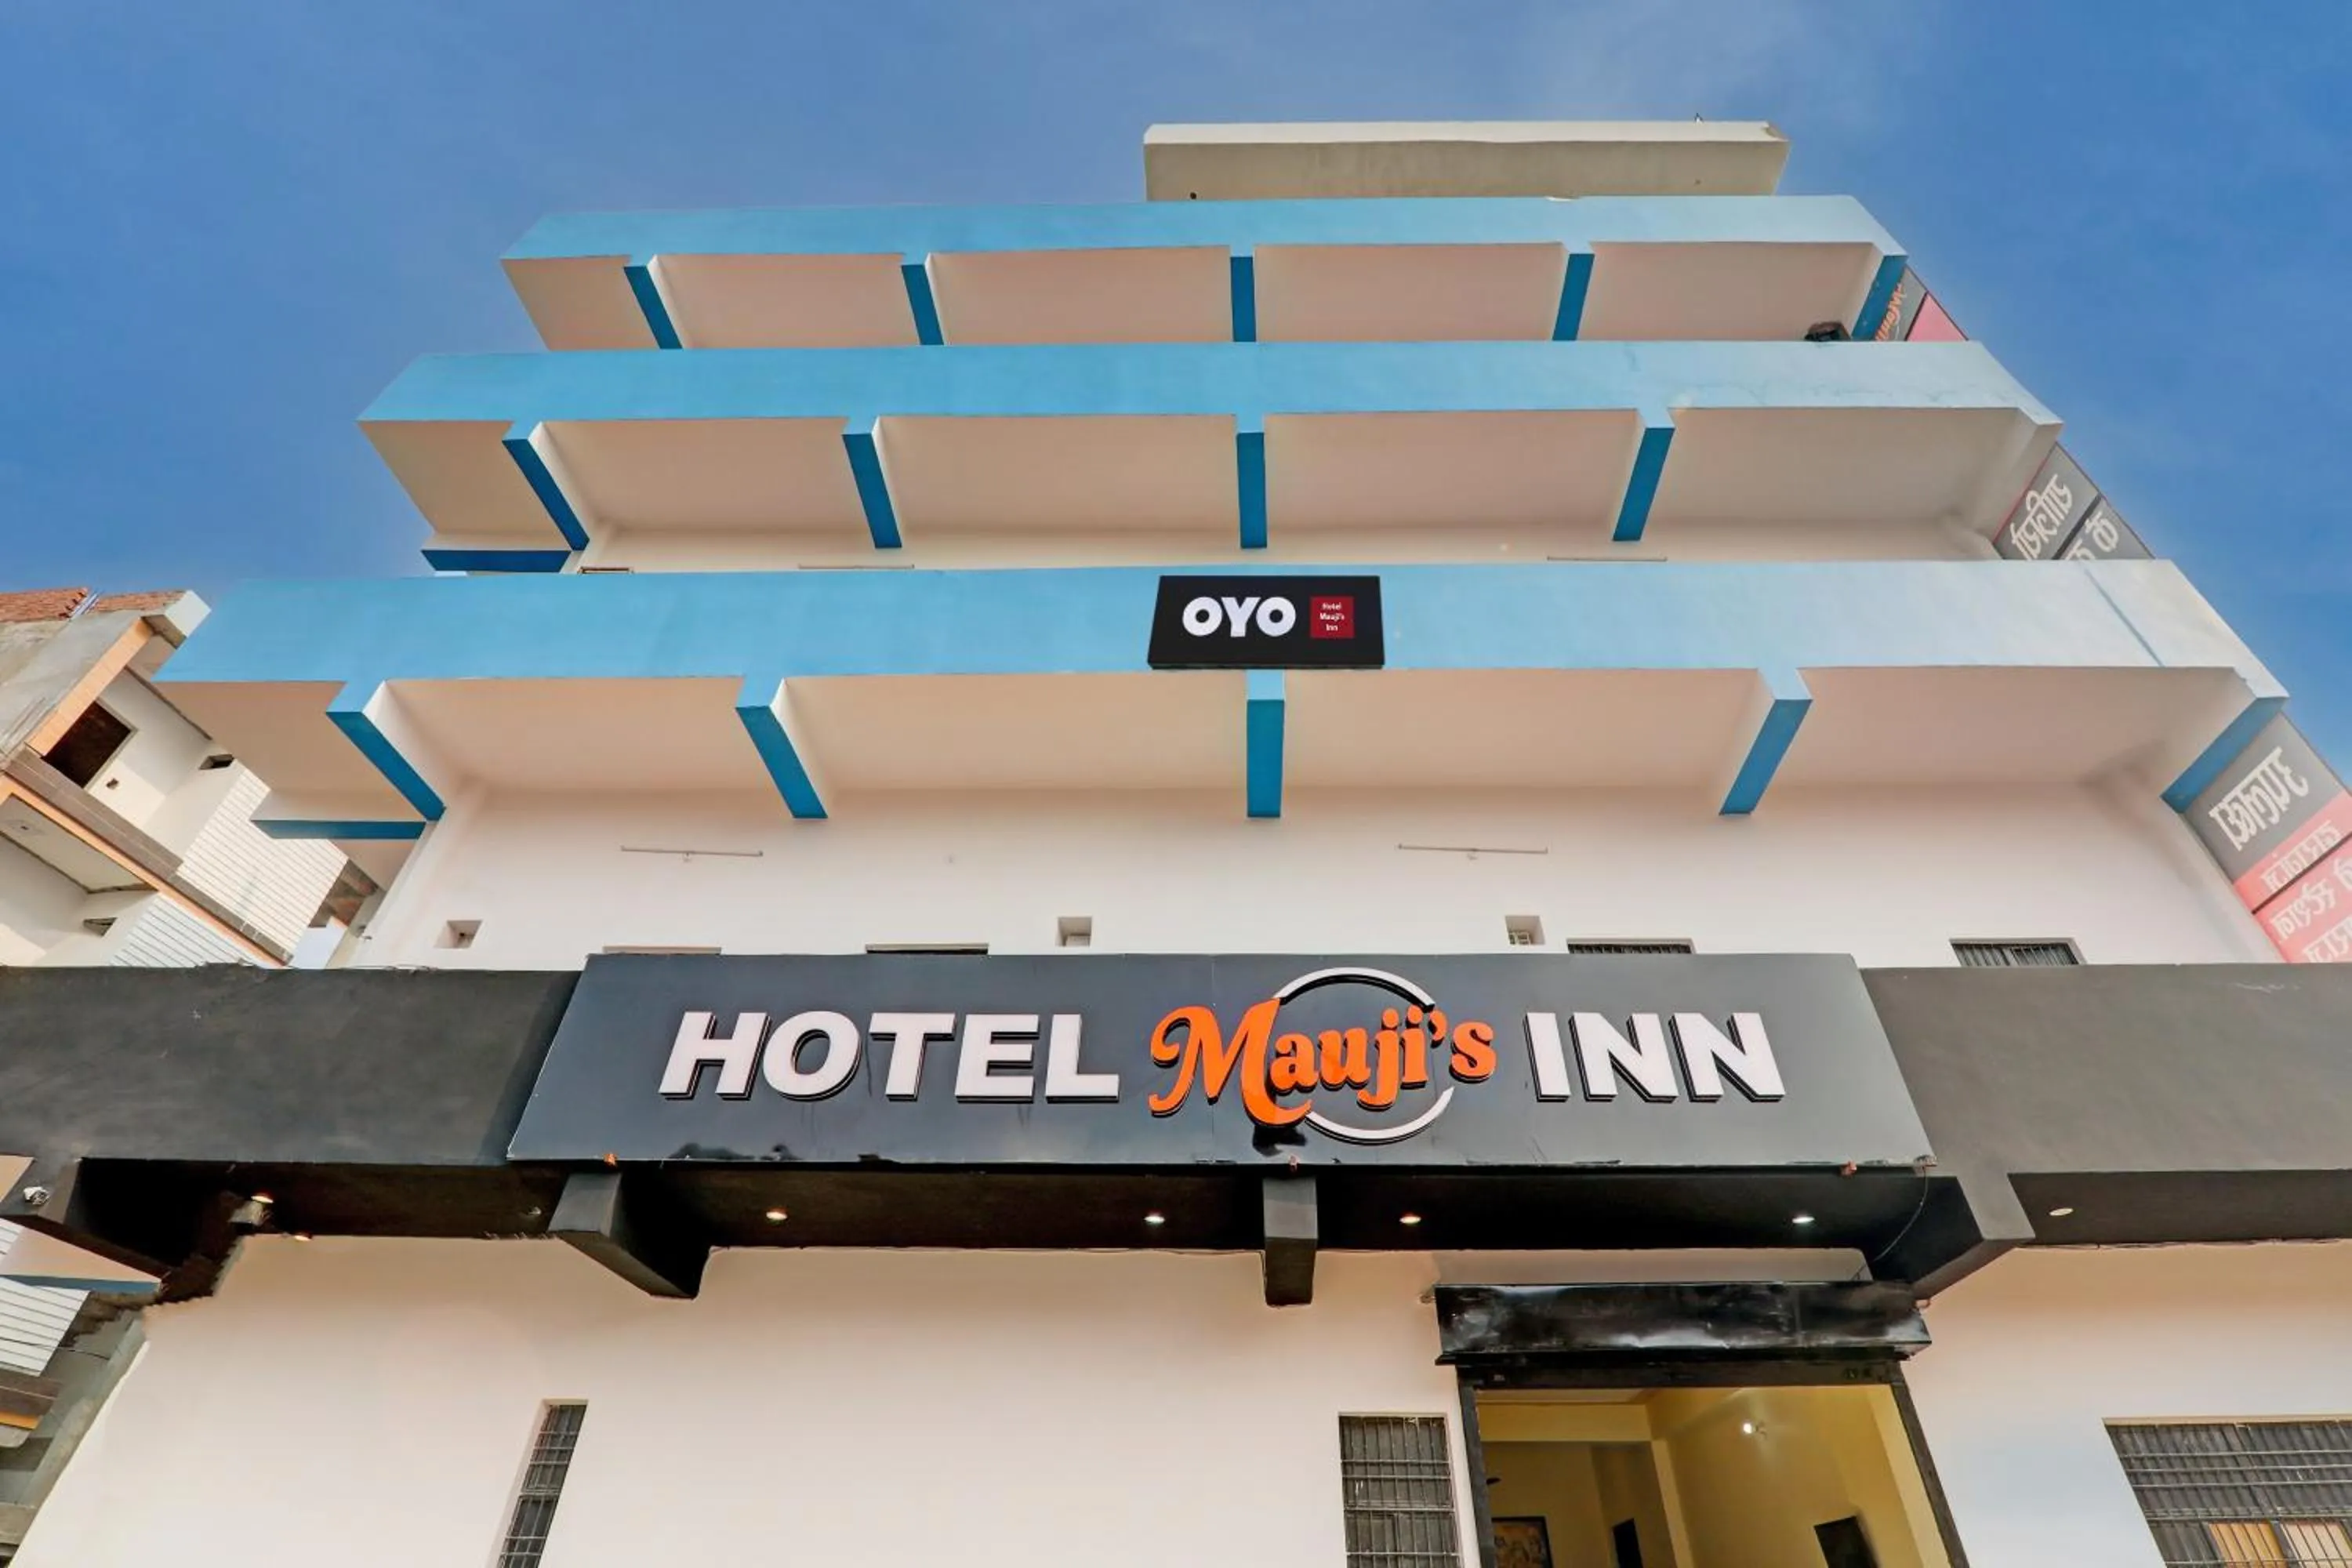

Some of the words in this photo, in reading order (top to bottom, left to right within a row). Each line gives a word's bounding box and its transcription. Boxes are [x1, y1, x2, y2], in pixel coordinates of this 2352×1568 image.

[1182, 597, 1296, 637] OYO
[659, 1011, 1120, 1102] HOTEL
[1148, 996, 1497, 1129] Mauji's
[1526, 1012, 1786, 1103] INN
